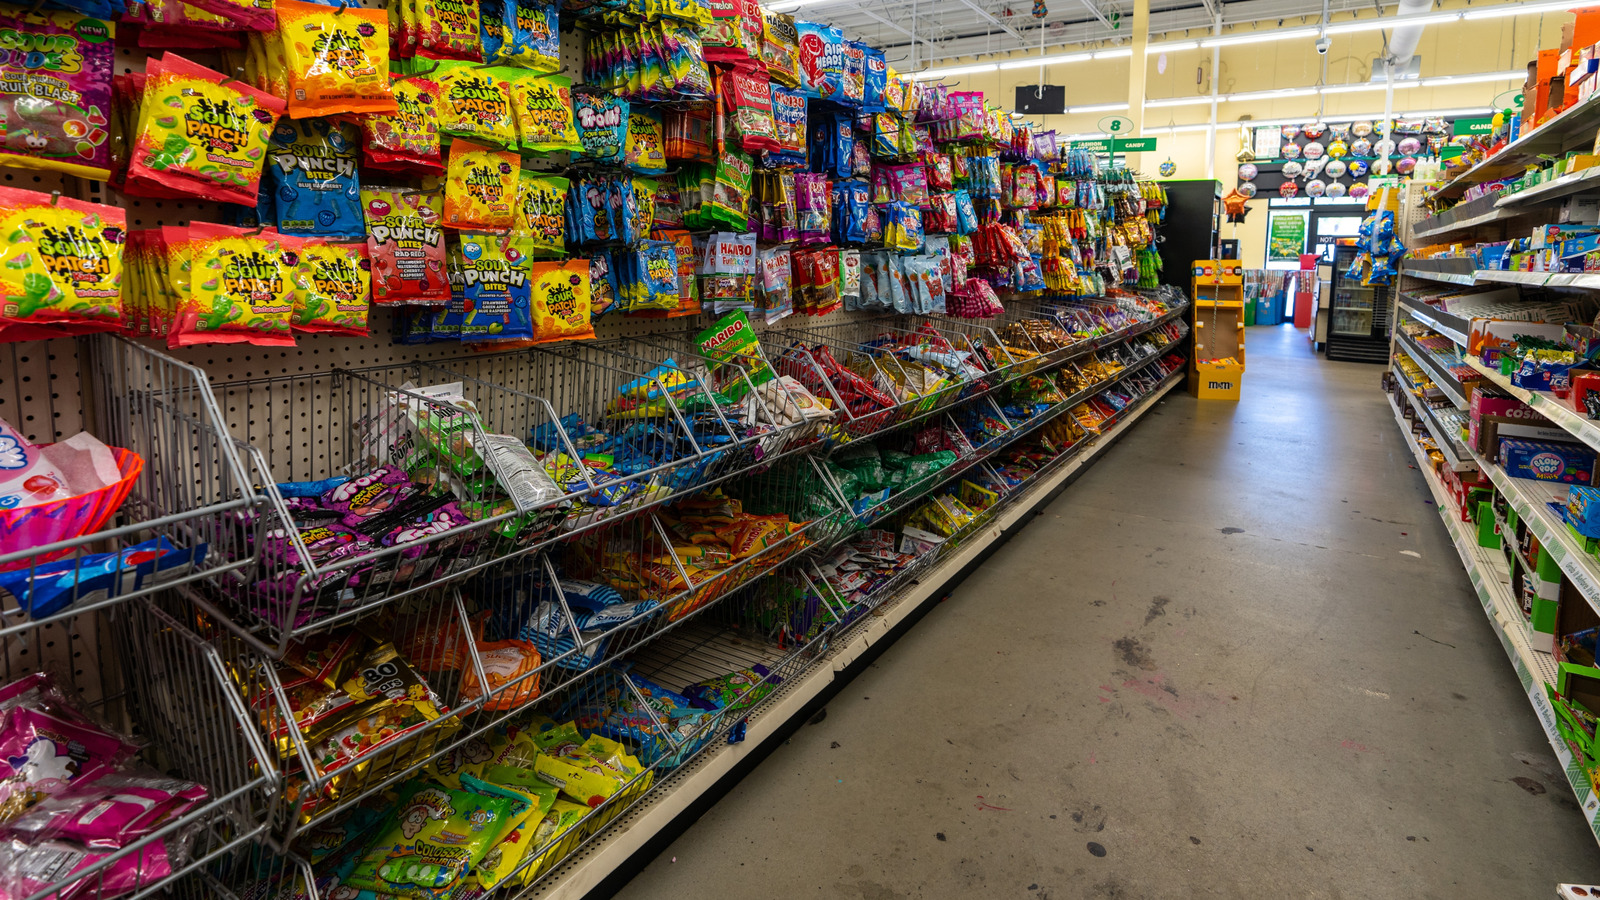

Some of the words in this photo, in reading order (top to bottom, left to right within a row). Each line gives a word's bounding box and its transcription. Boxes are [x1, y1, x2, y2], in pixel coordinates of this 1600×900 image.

[437, 11, 468, 25] PATCH
[516, 5, 546, 23] SOUR
[80, 25, 107, 38] NEW!
[516, 16, 550, 35] PATCH
[765, 14, 795, 38] HARIBO
[0, 29, 76, 54] SOUR
[314, 38, 361, 51] SOUR
[824, 42, 842, 57] AIR
[815, 55, 842, 70] HEADS
[4, 72, 28, 81] SOUR
[0, 81, 31, 94] RUIT
[35, 83, 79, 103] BLAST
[736, 76, 768, 95] HARIBO
[451, 86, 500, 101] SOUR
[774, 91, 805, 108] HARIBO
[453, 99, 506, 115] PATCH
[527, 97, 563, 111] SOUR
[190, 104, 247, 132] SOUR
[478, 111, 498, 121] Kids
[531, 109, 568, 124] PATCH
[578, 106, 620, 128] Trolli
[187, 118, 248, 147] PATCH
[630, 125, 655, 136] SOUR
[1110, 120, 1121, 131] 8
[210, 137, 234, 152] Kids
[633, 132, 658, 144] PATCH
[290, 144, 336, 158] SOUR
[207, 153, 255, 169] Watermelon
[277, 153, 354, 176] PUNCH
[306, 171, 335, 180] BITES
[467, 173, 501, 186] SOUR
[466, 184, 504, 197] PATCH
[524, 199, 563, 215] SOUR
[385, 215, 425, 230] SOUR
[526, 213, 565, 229] PATCH
[371, 225, 441, 246] PUNCH
[39, 238, 104, 258] SOUR
[397, 240, 423, 249] BITES
[720, 242, 752, 256] HARIBO
[41, 254, 110, 274] PATCH
[475, 260, 510, 271] SOUR
[648, 259, 670, 271] SOUR
[72, 271, 98, 282] Kids
[226, 265, 279, 280] SOUR
[316, 266, 359, 282] SOUR
[464, 269, 526, 287] PUNCH
[649, 268, 674, 280] PATCH
[225, 278, 283, 294] PATCH
[315, 279, 363, 294] PATCH
[485, 283, 507, 291] BITES
[546, 289, 574, 303] SOUR
[548, 300, 577, 314] PATCH
[700, 318, 743, 354] HARIBO
[1549, 378, 1568, 387] ICE
[1505, 408, 1547, 421] COSM
[1533, 457, 1560, 467] BLOW
[1538, 465, 1557, 473] POP
[395, 511, 457, 544] Trolli
[470, 811, 486, 824] 30
